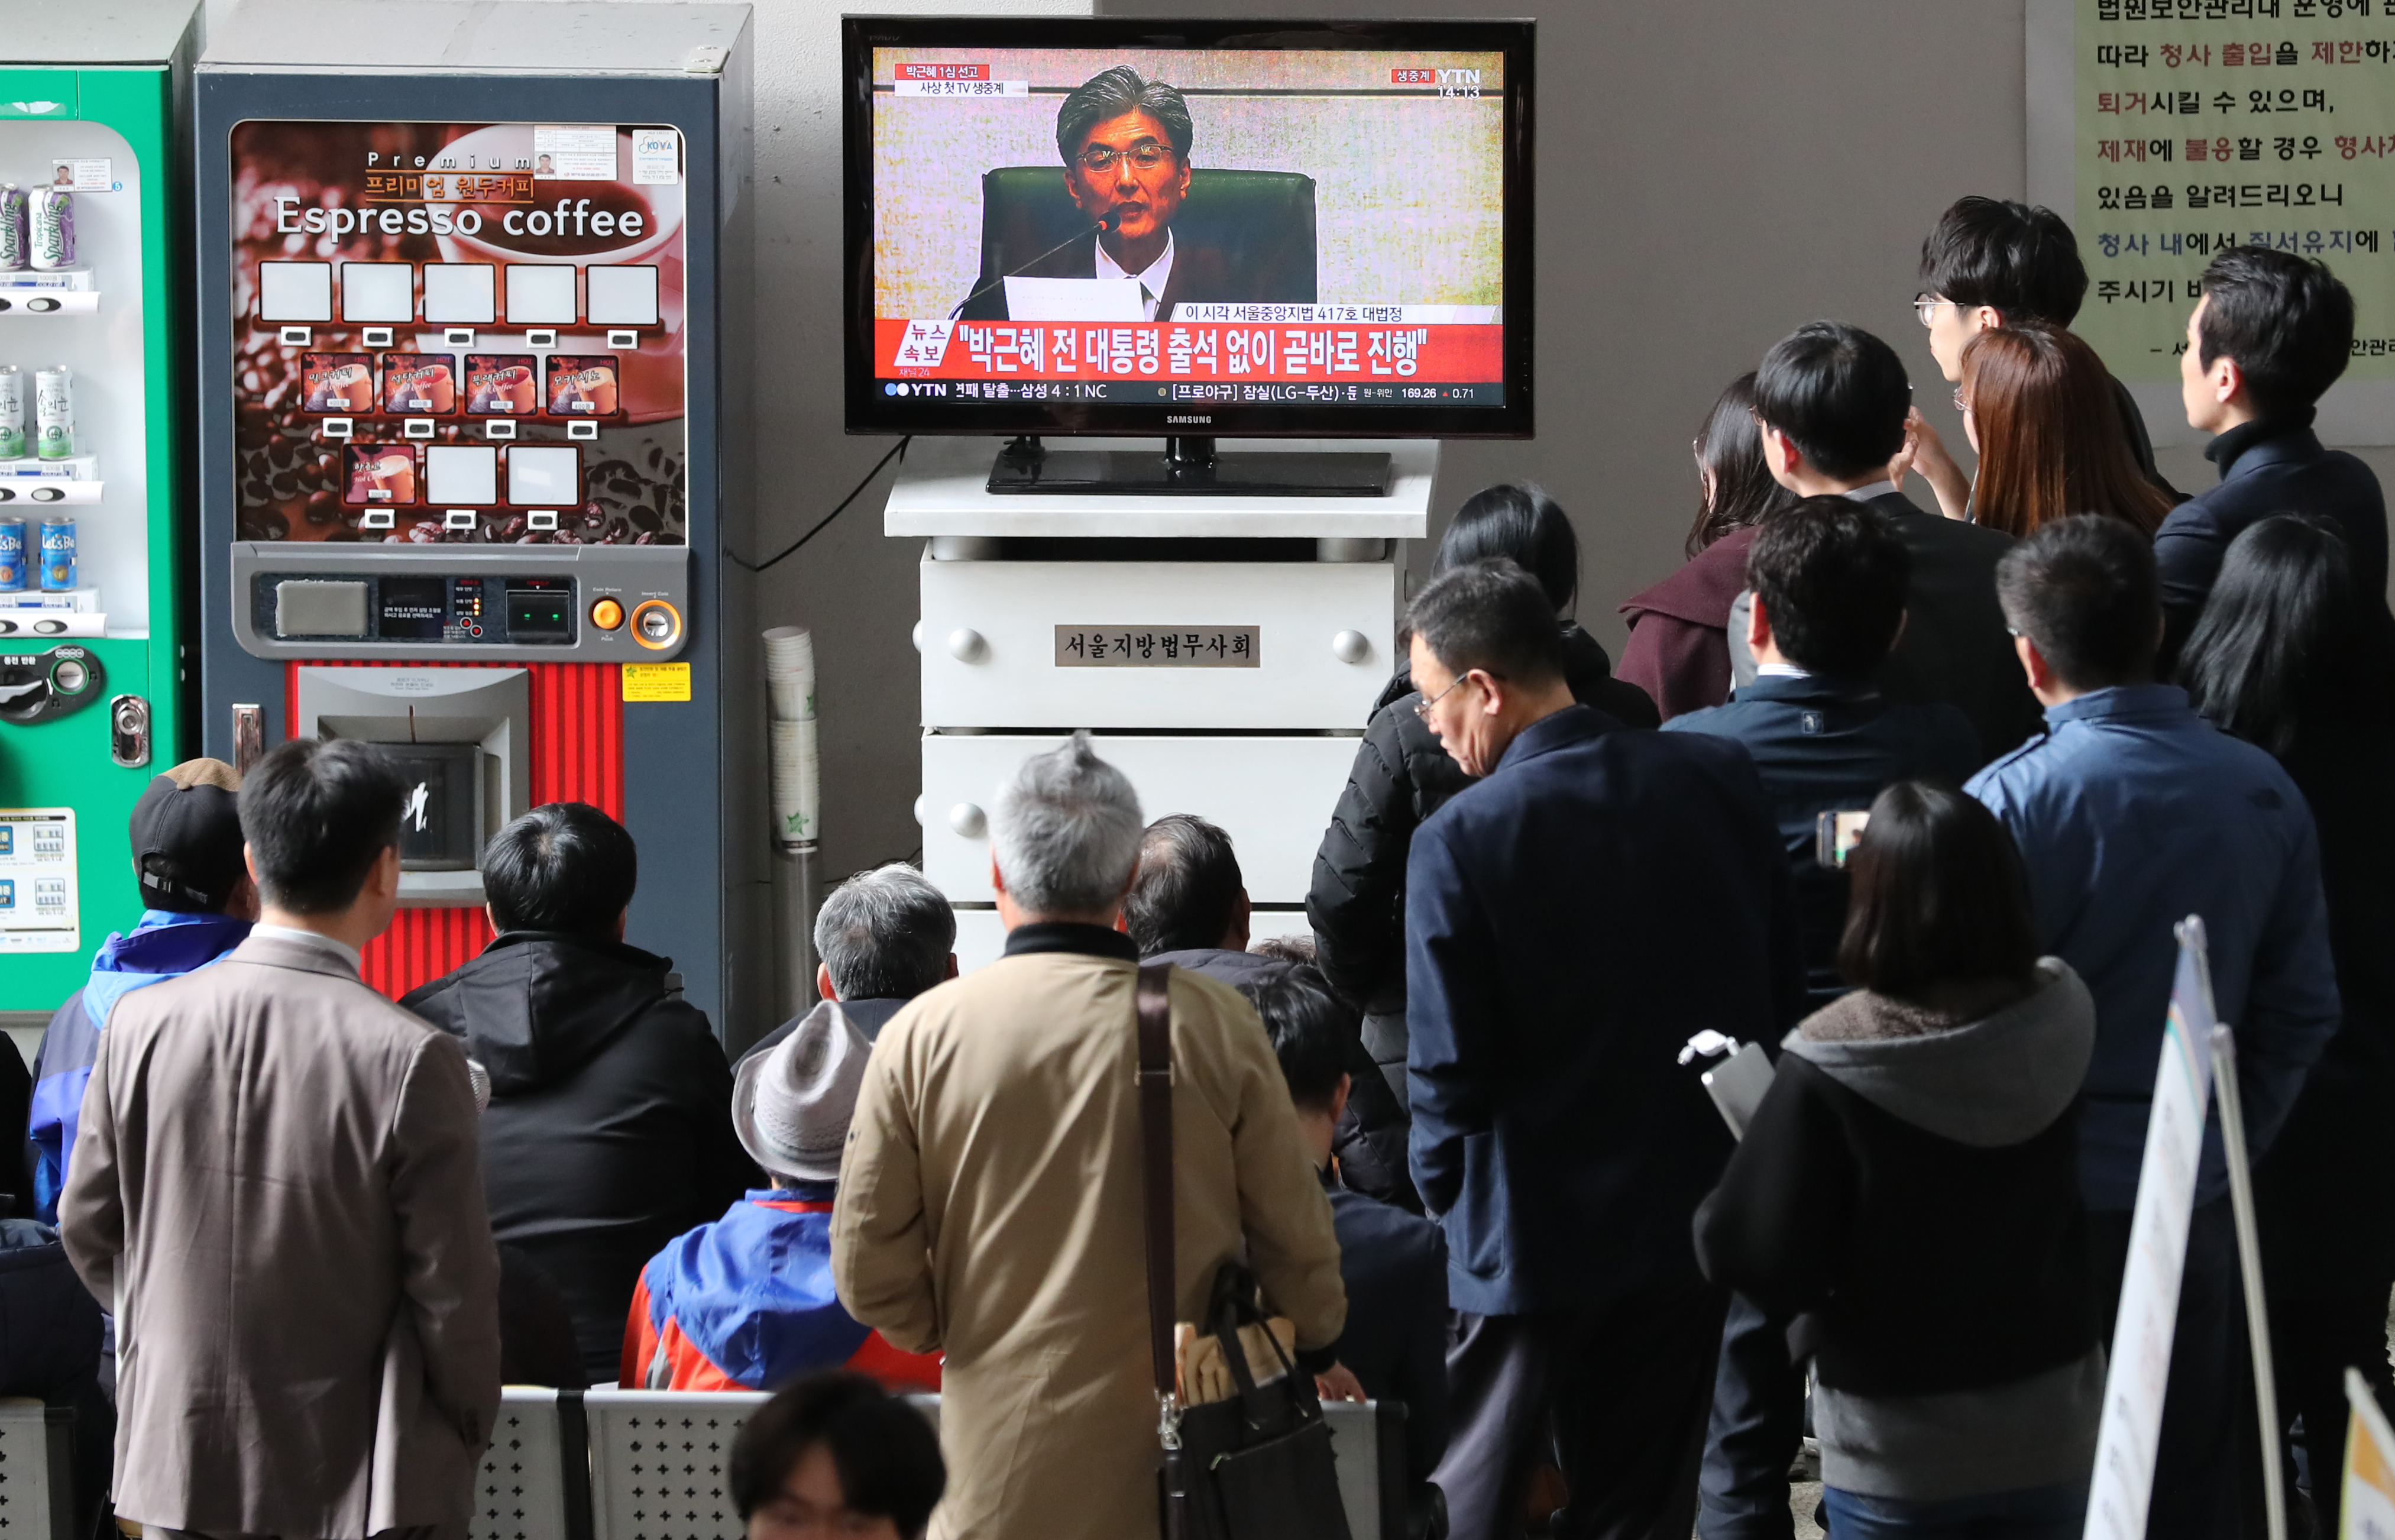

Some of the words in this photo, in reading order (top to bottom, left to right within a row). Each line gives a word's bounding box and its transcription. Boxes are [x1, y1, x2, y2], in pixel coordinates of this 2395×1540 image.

[2098, 45, 2148, 67] 따라
[2160, 43, 2211, 67] 청사
[2222, 41, 2298, 66] 출입을
[2312, 39, 2395, 64] 제한하
[906, 66, 937, 78] 박근혜
[939, 66, 955, 79] 1심
[958, 66, 979, 79] 선고
[1397, 70, 1430, 83] 생중계
[1438, 69, 1480, 83] YTN
[920, 82, 941, 95] 사상
[944, 82, 956, 95] 첫
[957, 82, 970, 93] TV
[972, 81, 1004, 95] 생중계
[1437, 85, 1481, 99] 14:13
[2098, 91, 2200, 115] 퇴거시킬
[2213, 91, 2236, 114] 수
[2249, 89, 2334, 114] 있으며,
[648, 140, 672, 151] KOVA
[2098, 139, 2173, 163] 제재에
[2185, 137, 2261, 162] 불응할
[2274, 137, 2322, 160] 경우
[368, 151, 531, 169] Premium
[365, 175, 445, 199] 프리미엄
[455, 176, 535, 199] 원두커피
[2098, 186, 2174, 210] 있음을
[2186, 184, 2343, 208] 알려드리오니
[274, 196, 483, 244] Espresso
[503, 198, 643, 237] coffee
[0, 203, 18, 261] Sparkling
[44, 203, 64, 262] Sparkling
[2098, 233, 2148, 258] 청사
[2160, 232, 2237, 256] 내에서
[2249, 230, 2378, 254] 질서유지에
[2098, 280, 2173, 303] 주시기
[1186, 306, 1199, 321] 이
[1203, 306, 1228, 321] 시각
[1234, 306, 1313, 322] 서울중앙지법
[1318, 306, 1358, 321] 417호
[1362, 306, 1402, 322] 대법정
[911, 324, 947, 341] 뉴스
[904, 345, 940, 363] 속보
[959, 325, 1045, 374] "박근혜
[1052, 327, 1077, 374] 전
[1086, 328, 1160, 375] 대통령
[1167, 328, 1218, 375] 출석
[1226, 328, 1276, 375] 없이
[1283, 329, 1361, 376] 곧바로
[1367, 328, 1428, 377] 진행"
[308, 367, 352, 384] 밀크커피
[390, 368, 435, 385] 설탕커피
[471, 369, 517, 386] 블랙커피
[411, 382, 432, 392] Coffee
[493, 383, 513, 393] Coffee
[911, 383, 946, 397] YTN
[1085, 384, 1107, 398] NC
[1173, 383, 1238, 401] [프로야구]
[1402, 388, 1436, 399] 169.26
[1452, 388, 1475, 399] 0.71
[38, 389, 69, 416] 솔의눈
[1167, 416, 1212, 424] SAMSUNG
[1065, 633, 1250, 659] 서울지방법무사회
